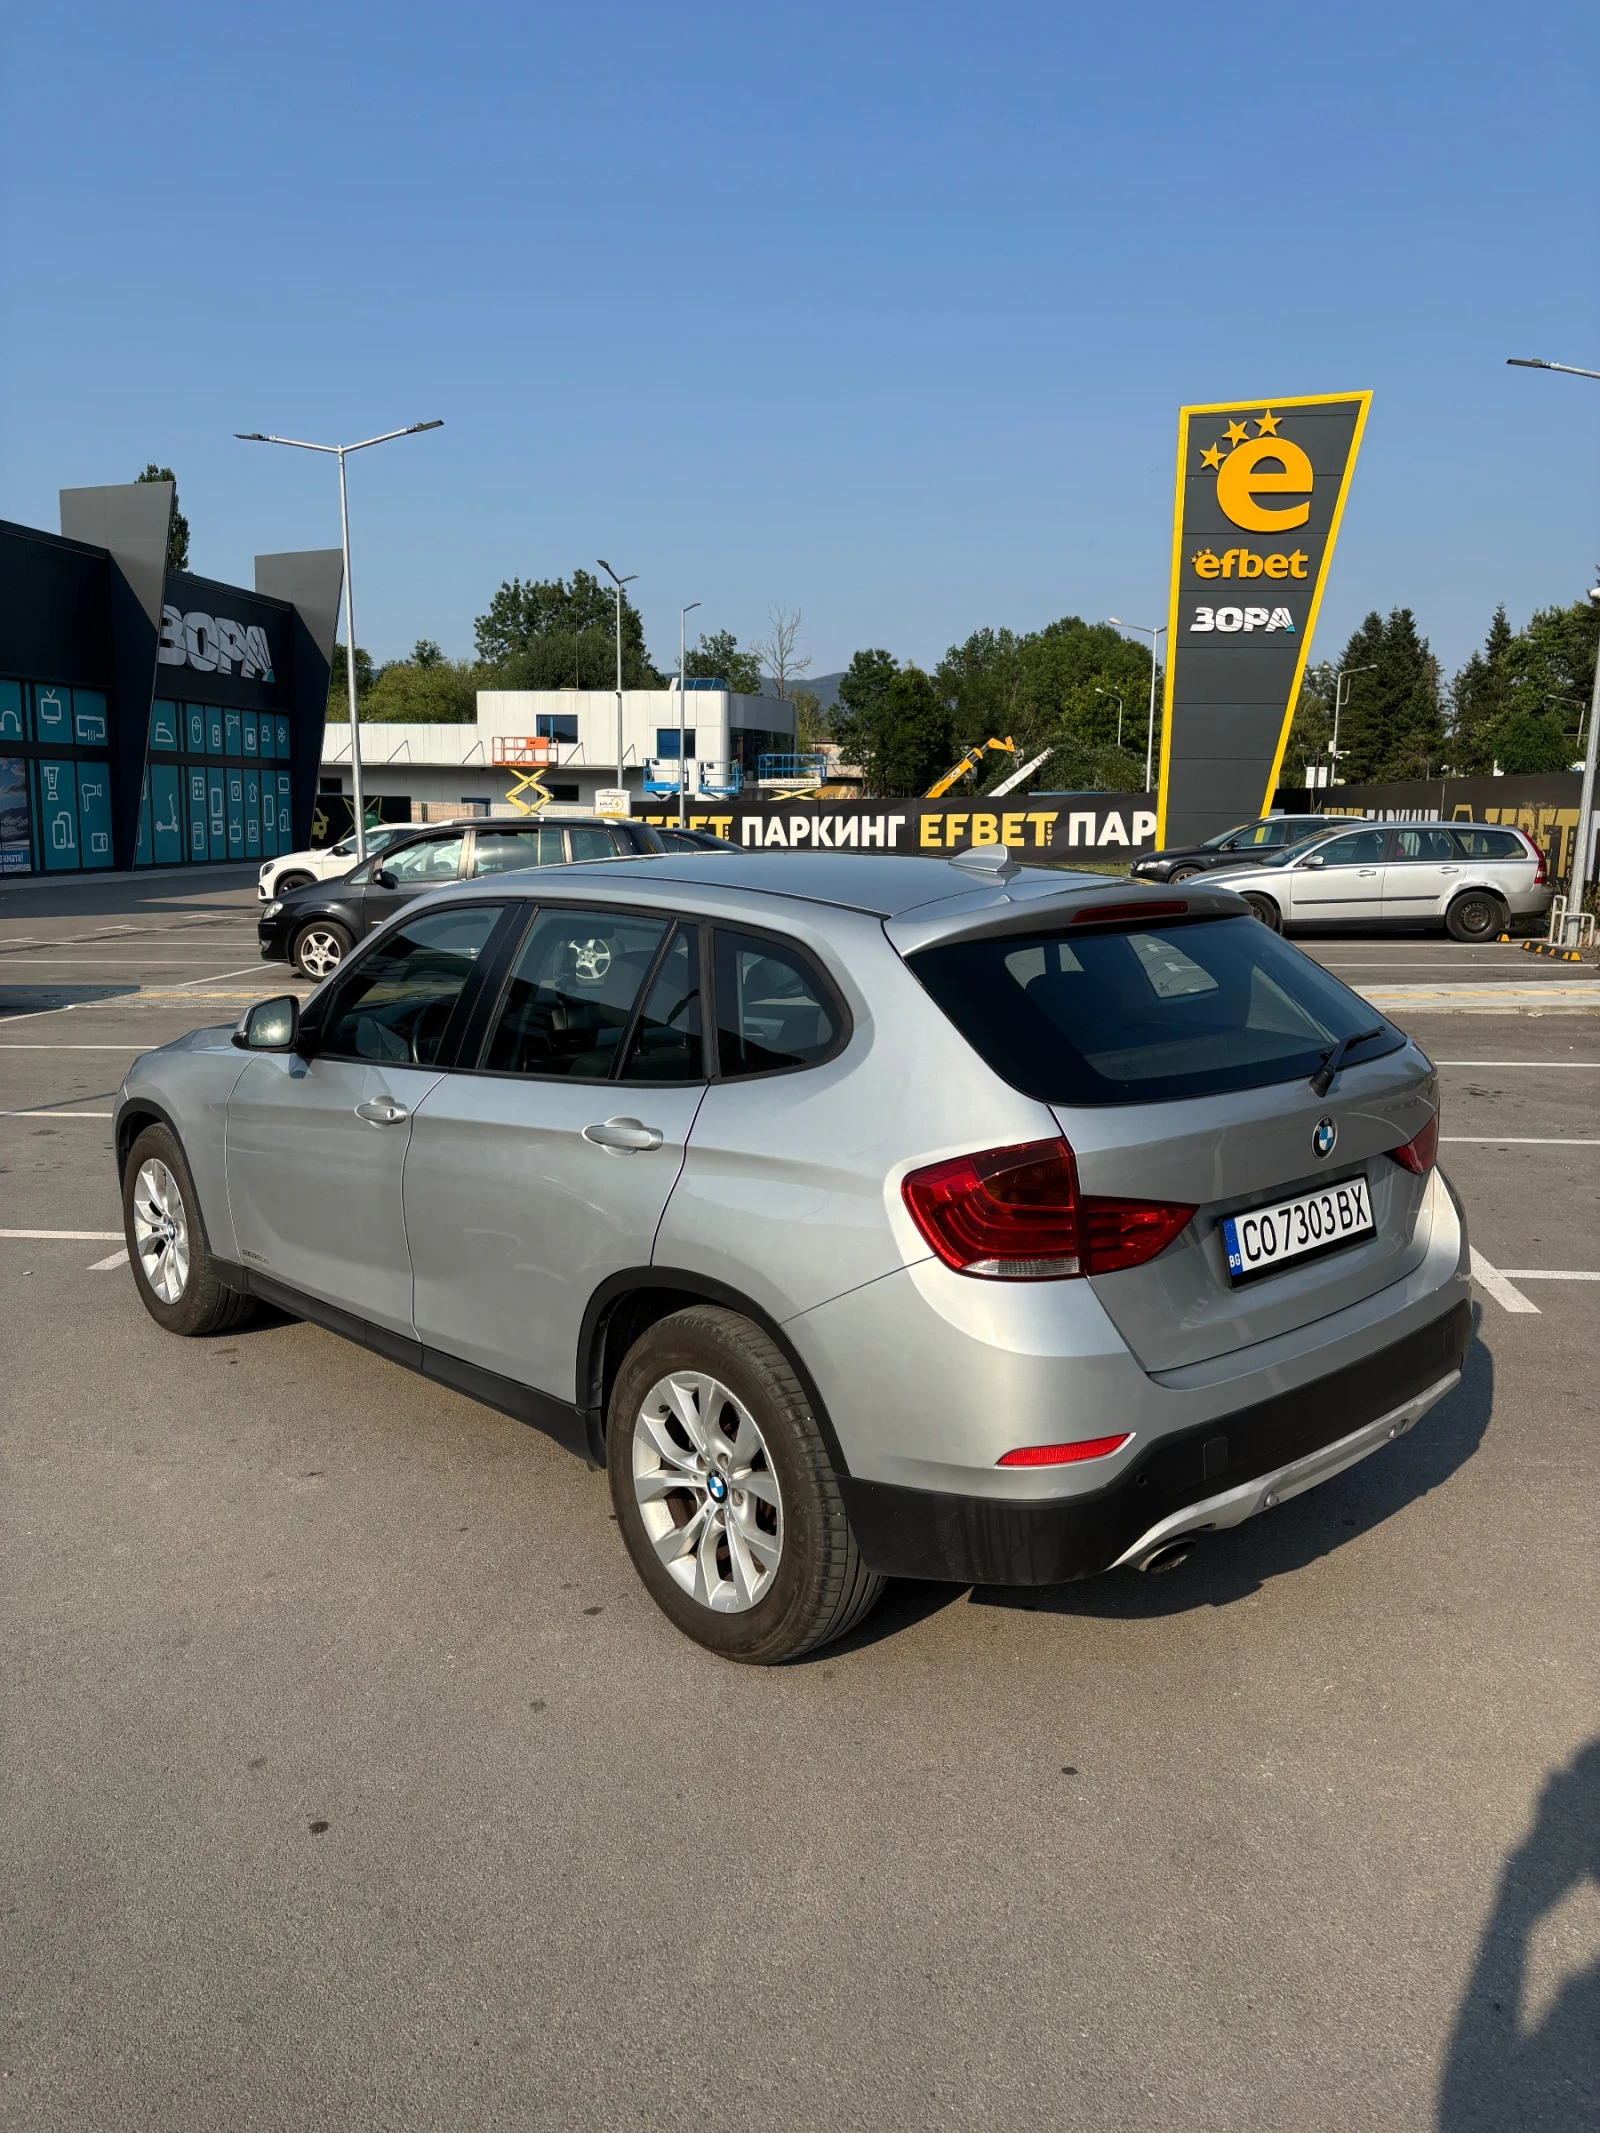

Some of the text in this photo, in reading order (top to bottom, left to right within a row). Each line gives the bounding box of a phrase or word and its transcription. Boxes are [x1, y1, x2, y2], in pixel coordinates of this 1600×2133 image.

[1195, 548, 1309, 579] efbet
[1190, 606, 1295, 632] ЗОРА
[158, 604, 275, 683] ЗОРА
[742, 816, 906, 847] ПАРКИНГ
[920, 812, 1058, 847] EFBET
[1278, 1196, 1336, 1251] 7303
[1229, 1254, 1241, 1268] BG
